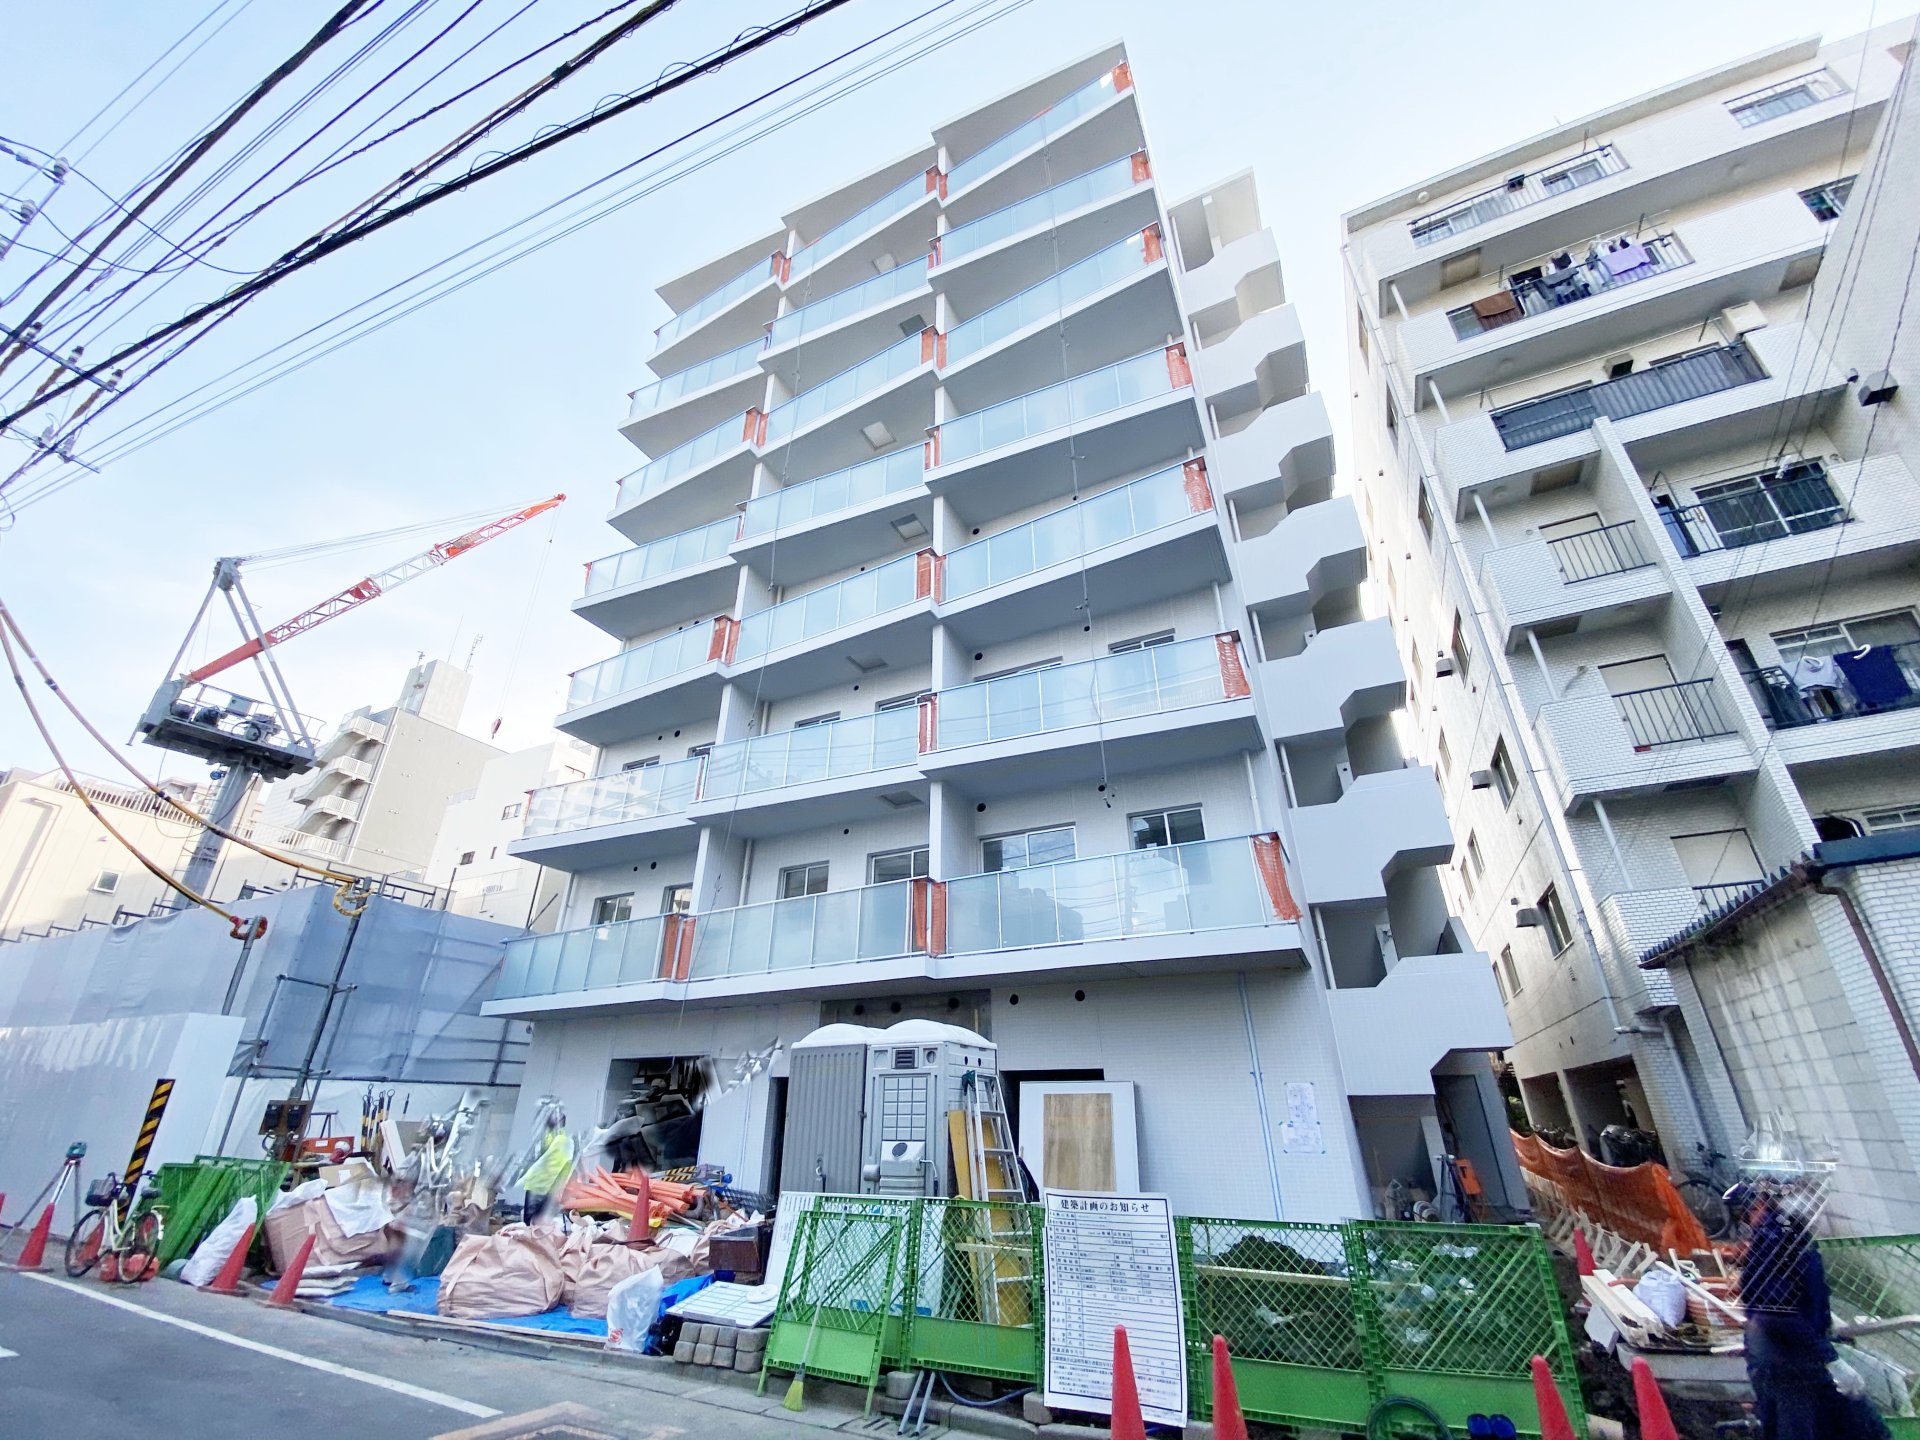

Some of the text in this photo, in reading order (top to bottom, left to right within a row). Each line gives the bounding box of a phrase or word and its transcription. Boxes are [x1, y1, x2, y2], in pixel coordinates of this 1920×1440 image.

[1061, 1199, 1150, 1213] 建築計画のお知らせ
